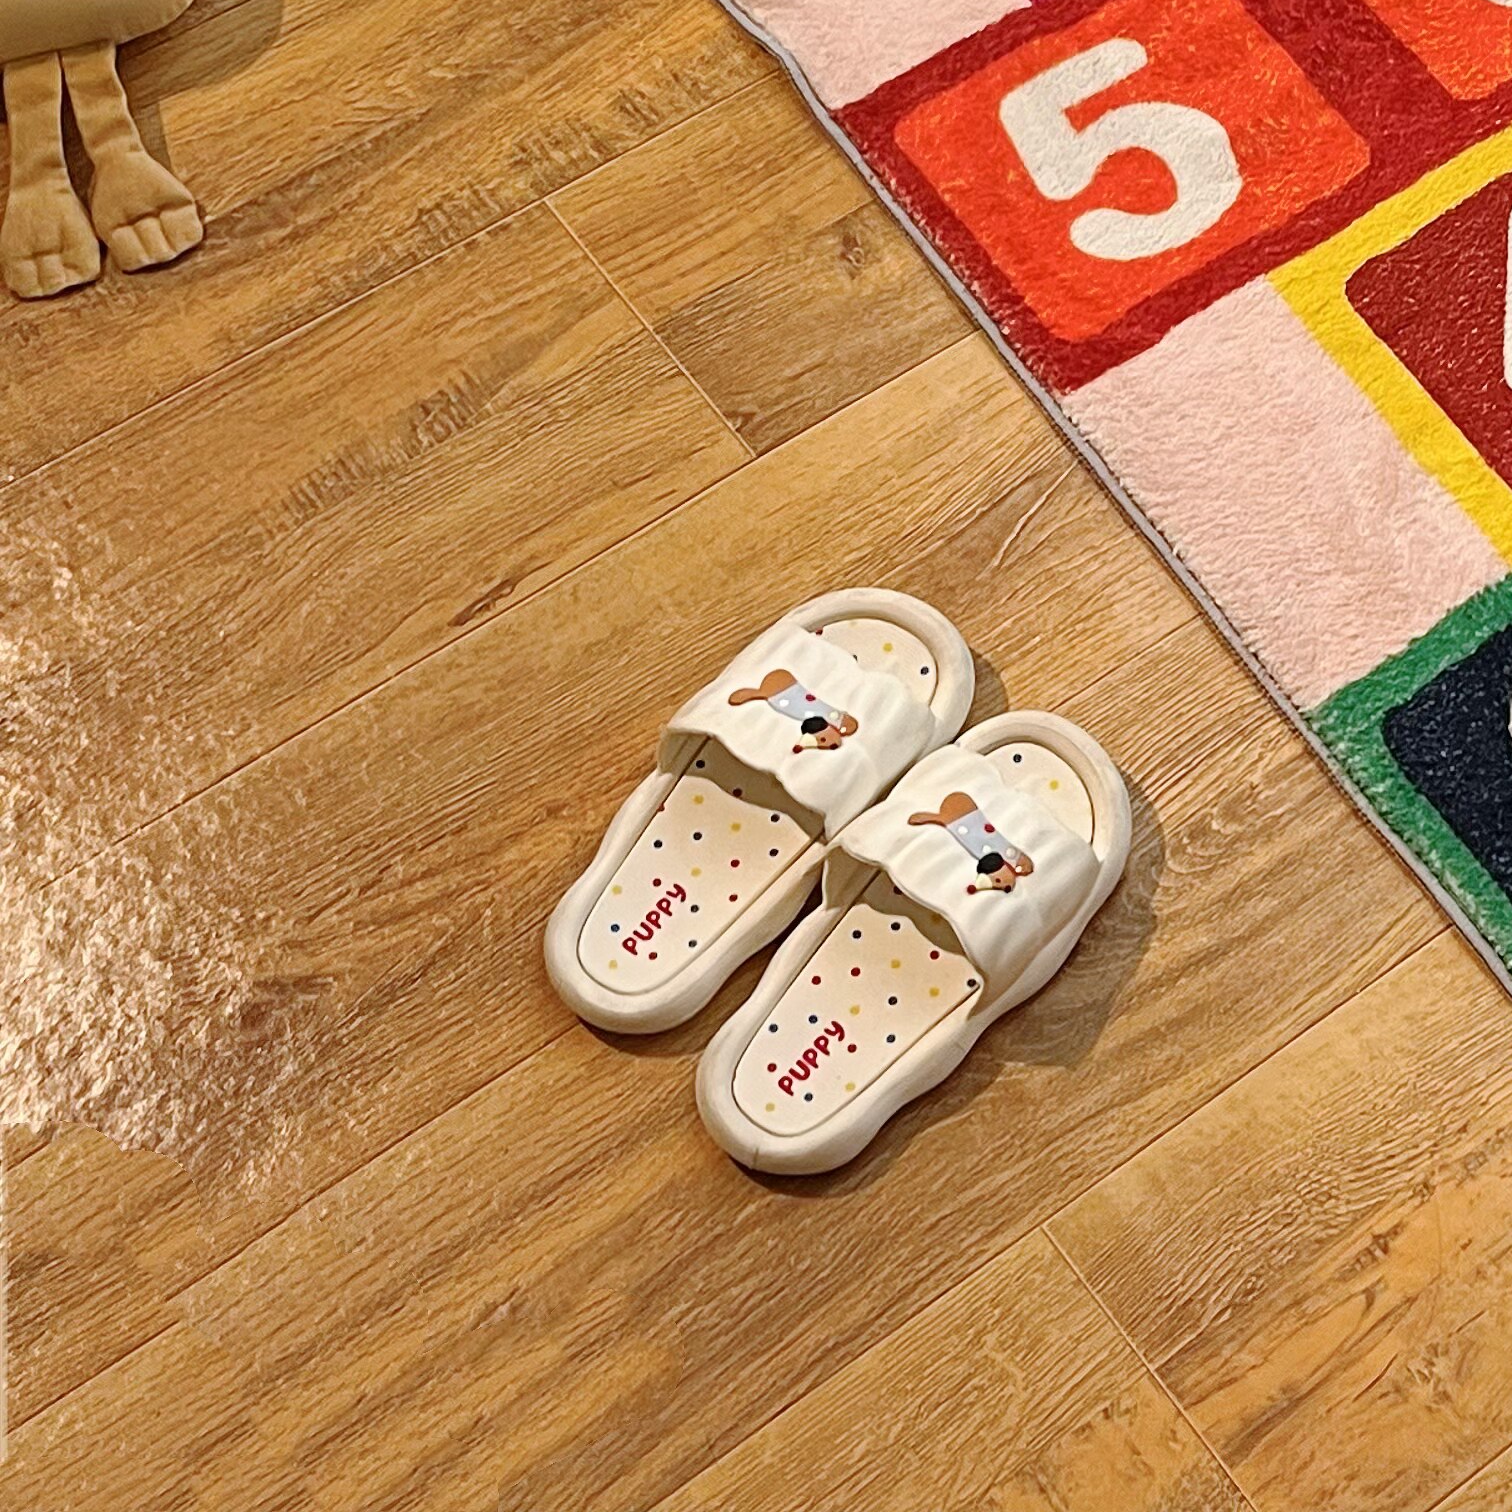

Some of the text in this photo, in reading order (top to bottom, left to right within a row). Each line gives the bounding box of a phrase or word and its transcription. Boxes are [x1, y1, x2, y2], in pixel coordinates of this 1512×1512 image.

[1000, 40, 1242, 260] 5
[622, 883, 687, 955] PUPPY
[778, 1021, 845, 1095] PUPPY
